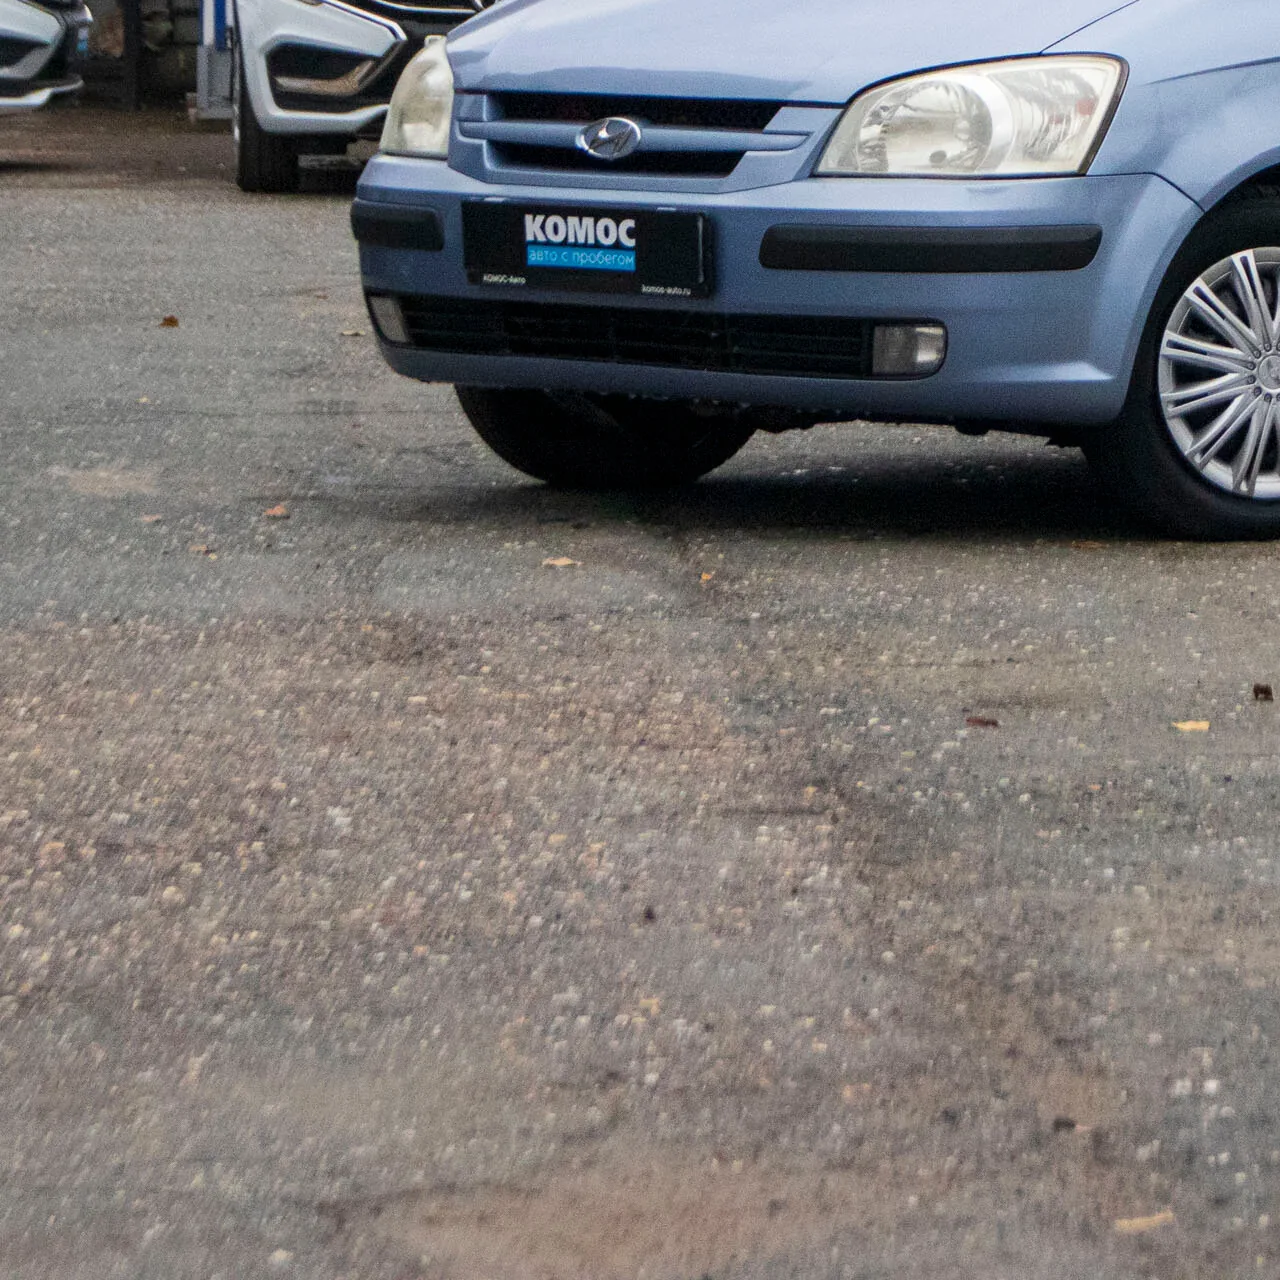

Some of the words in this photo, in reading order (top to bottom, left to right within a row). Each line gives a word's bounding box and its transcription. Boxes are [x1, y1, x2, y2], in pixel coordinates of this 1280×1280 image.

[524, 213, 636, 247] КОМОС
[528, 250, 558, 261] авто
[561, 251, 569, 262] с
[572, 250, 634, 265] пробегом
